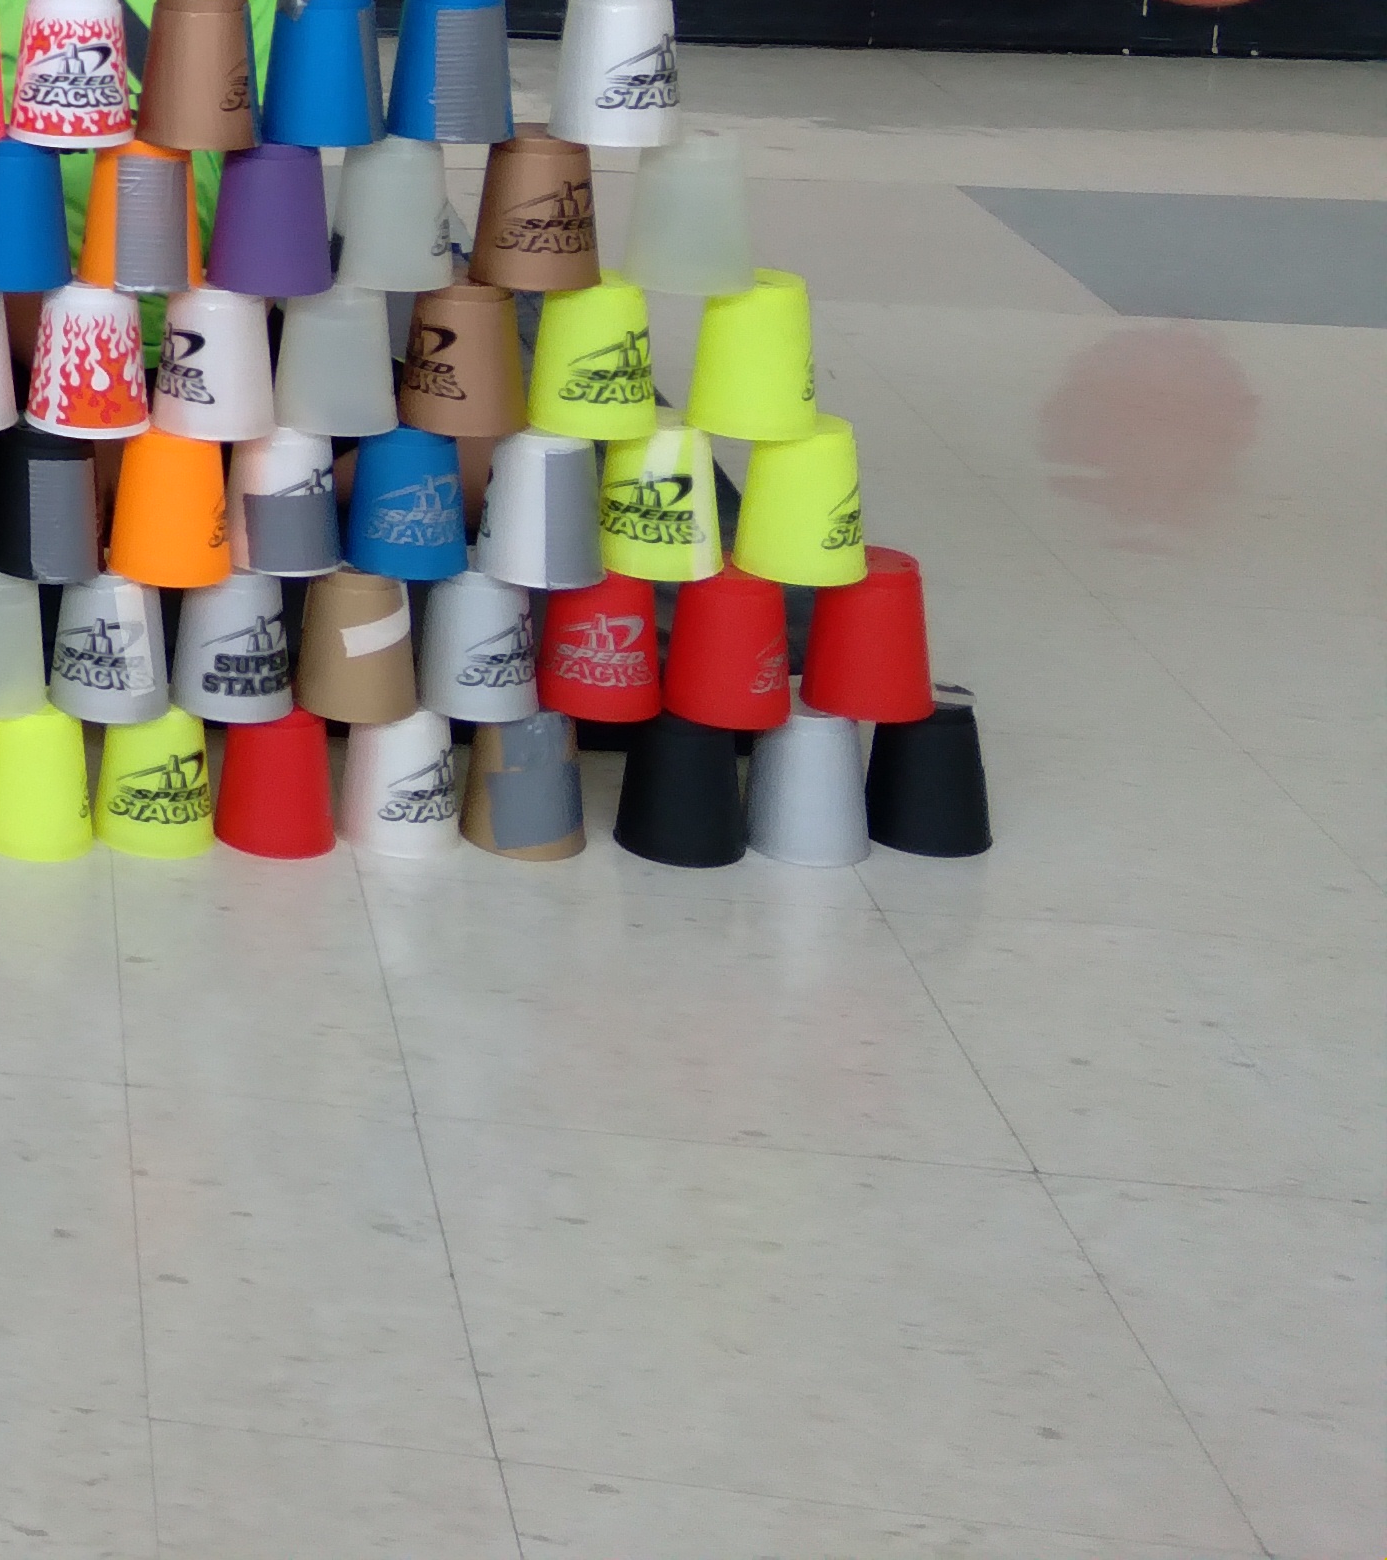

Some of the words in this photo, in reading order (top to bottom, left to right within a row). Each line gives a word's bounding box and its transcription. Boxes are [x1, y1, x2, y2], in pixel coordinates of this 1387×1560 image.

[40, 75, 114, 86] SPEED
[627, 74, 678, 88] SPE
[20, 83, 123, 108] STACKS
[595, 85, 679, 110] STAC
[591, 366, 651, 382] SPEE
[609, 502, 692, 522] SPEED
[378, 797, 455, 823] STAC
